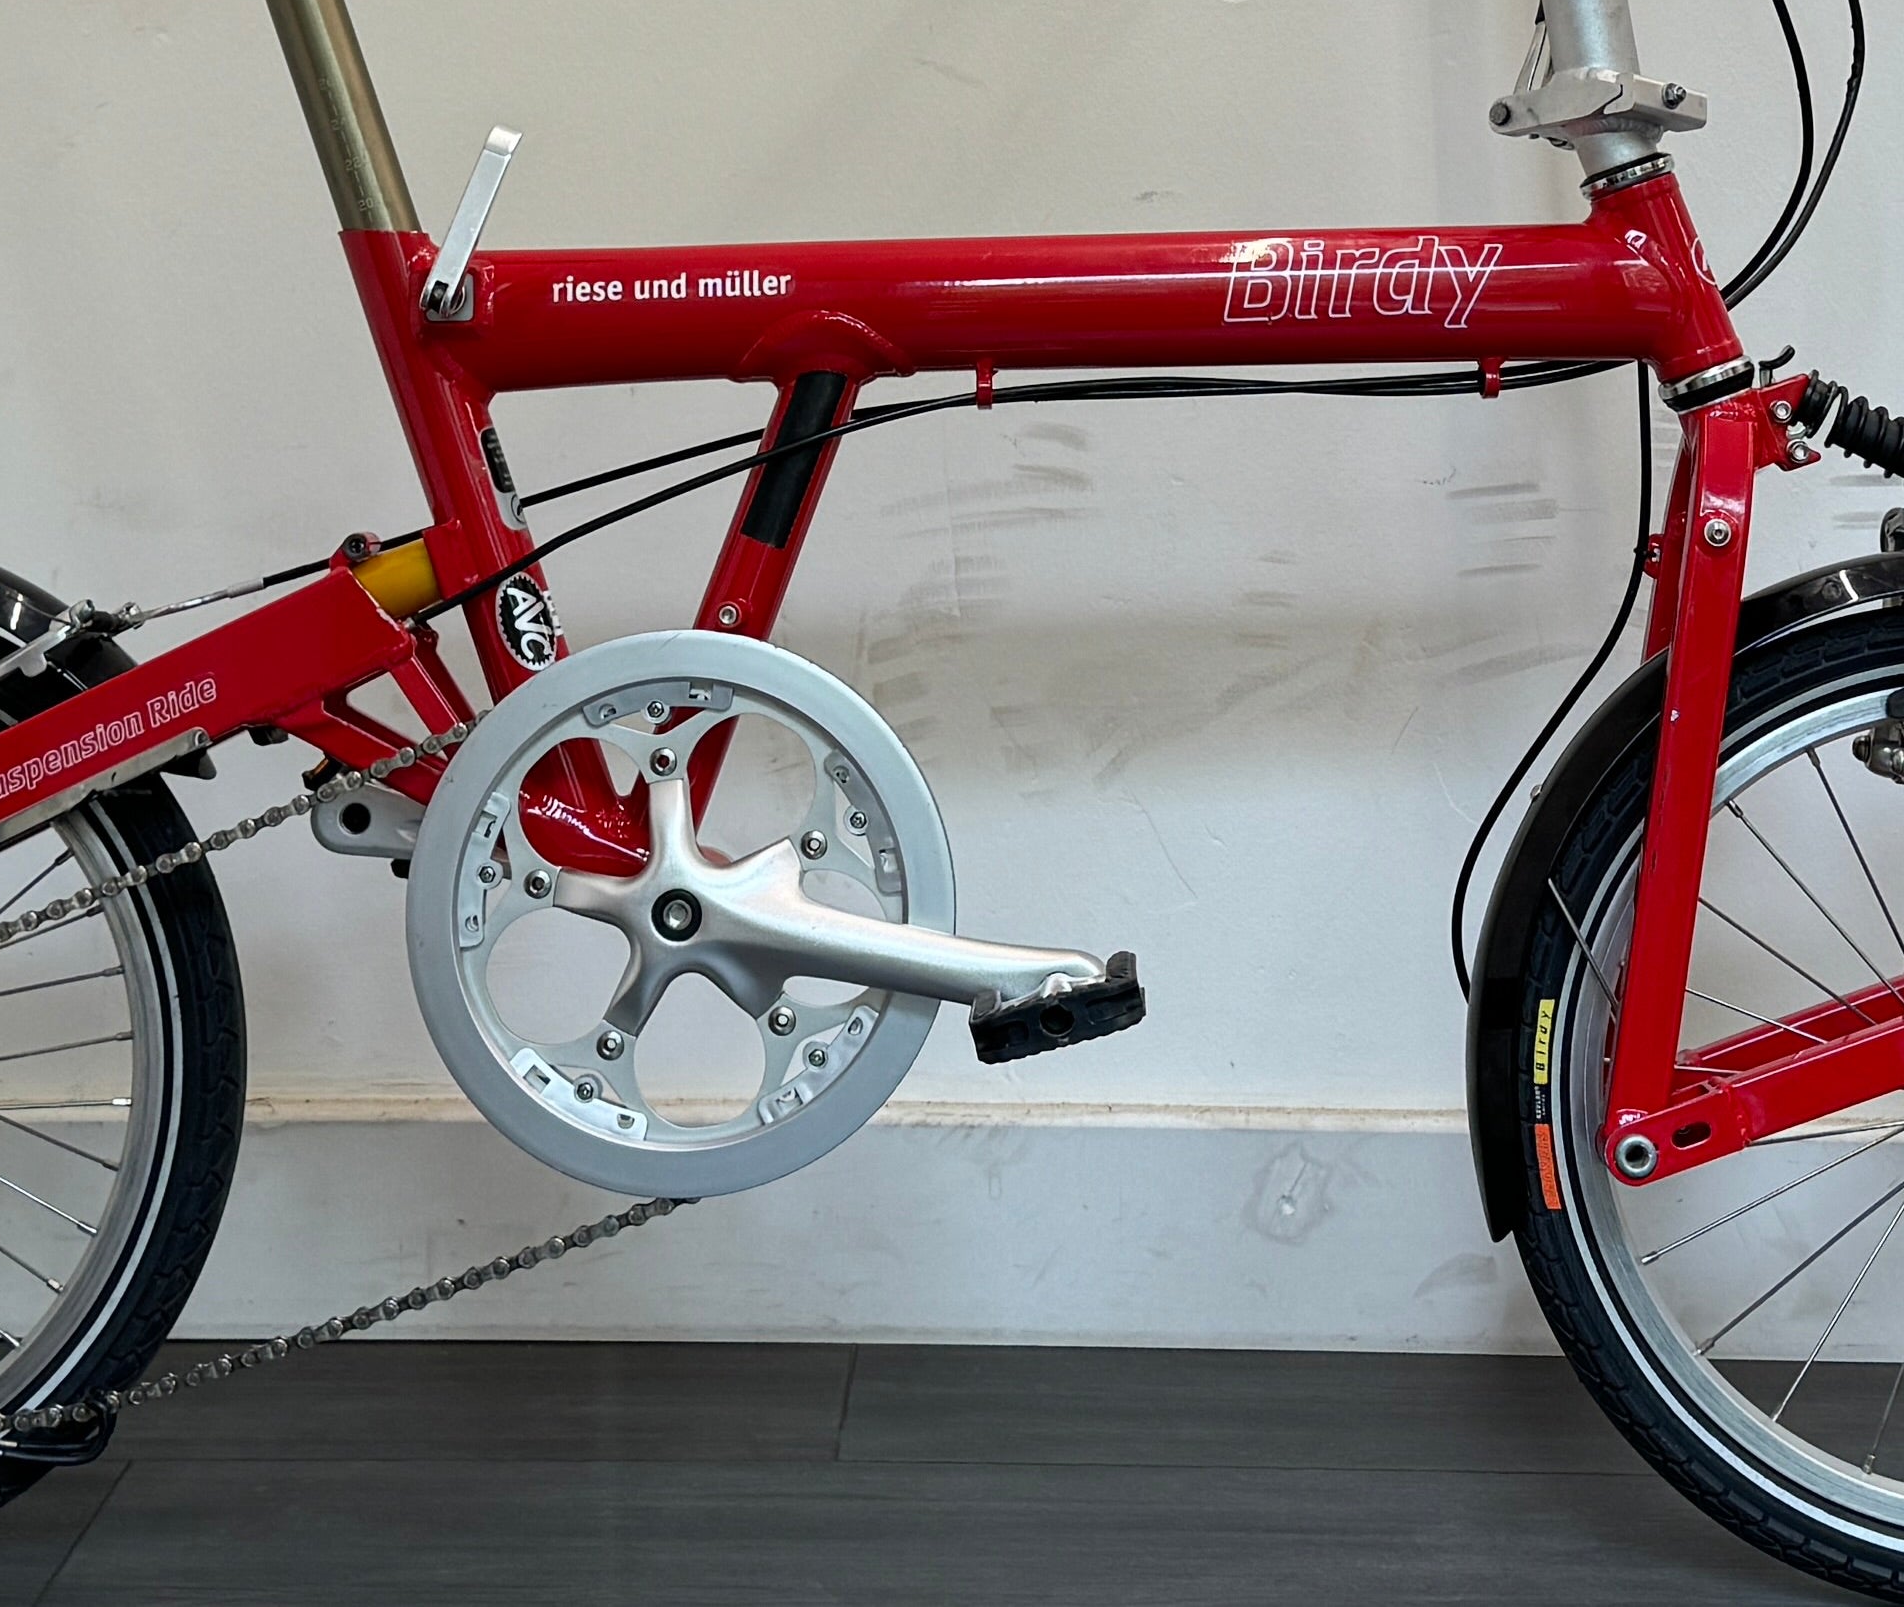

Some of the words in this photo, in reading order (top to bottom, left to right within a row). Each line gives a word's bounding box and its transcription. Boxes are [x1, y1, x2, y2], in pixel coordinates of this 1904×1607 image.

[552, 275, 623, 303] riese
[634, 272, 687, 299] und
[698, 269, 792, 297] müller
[1223, 235, 1503, 328] Birdy
[506, 587, 553, 661] AVC
[146, 677, 217, 728] Ride
